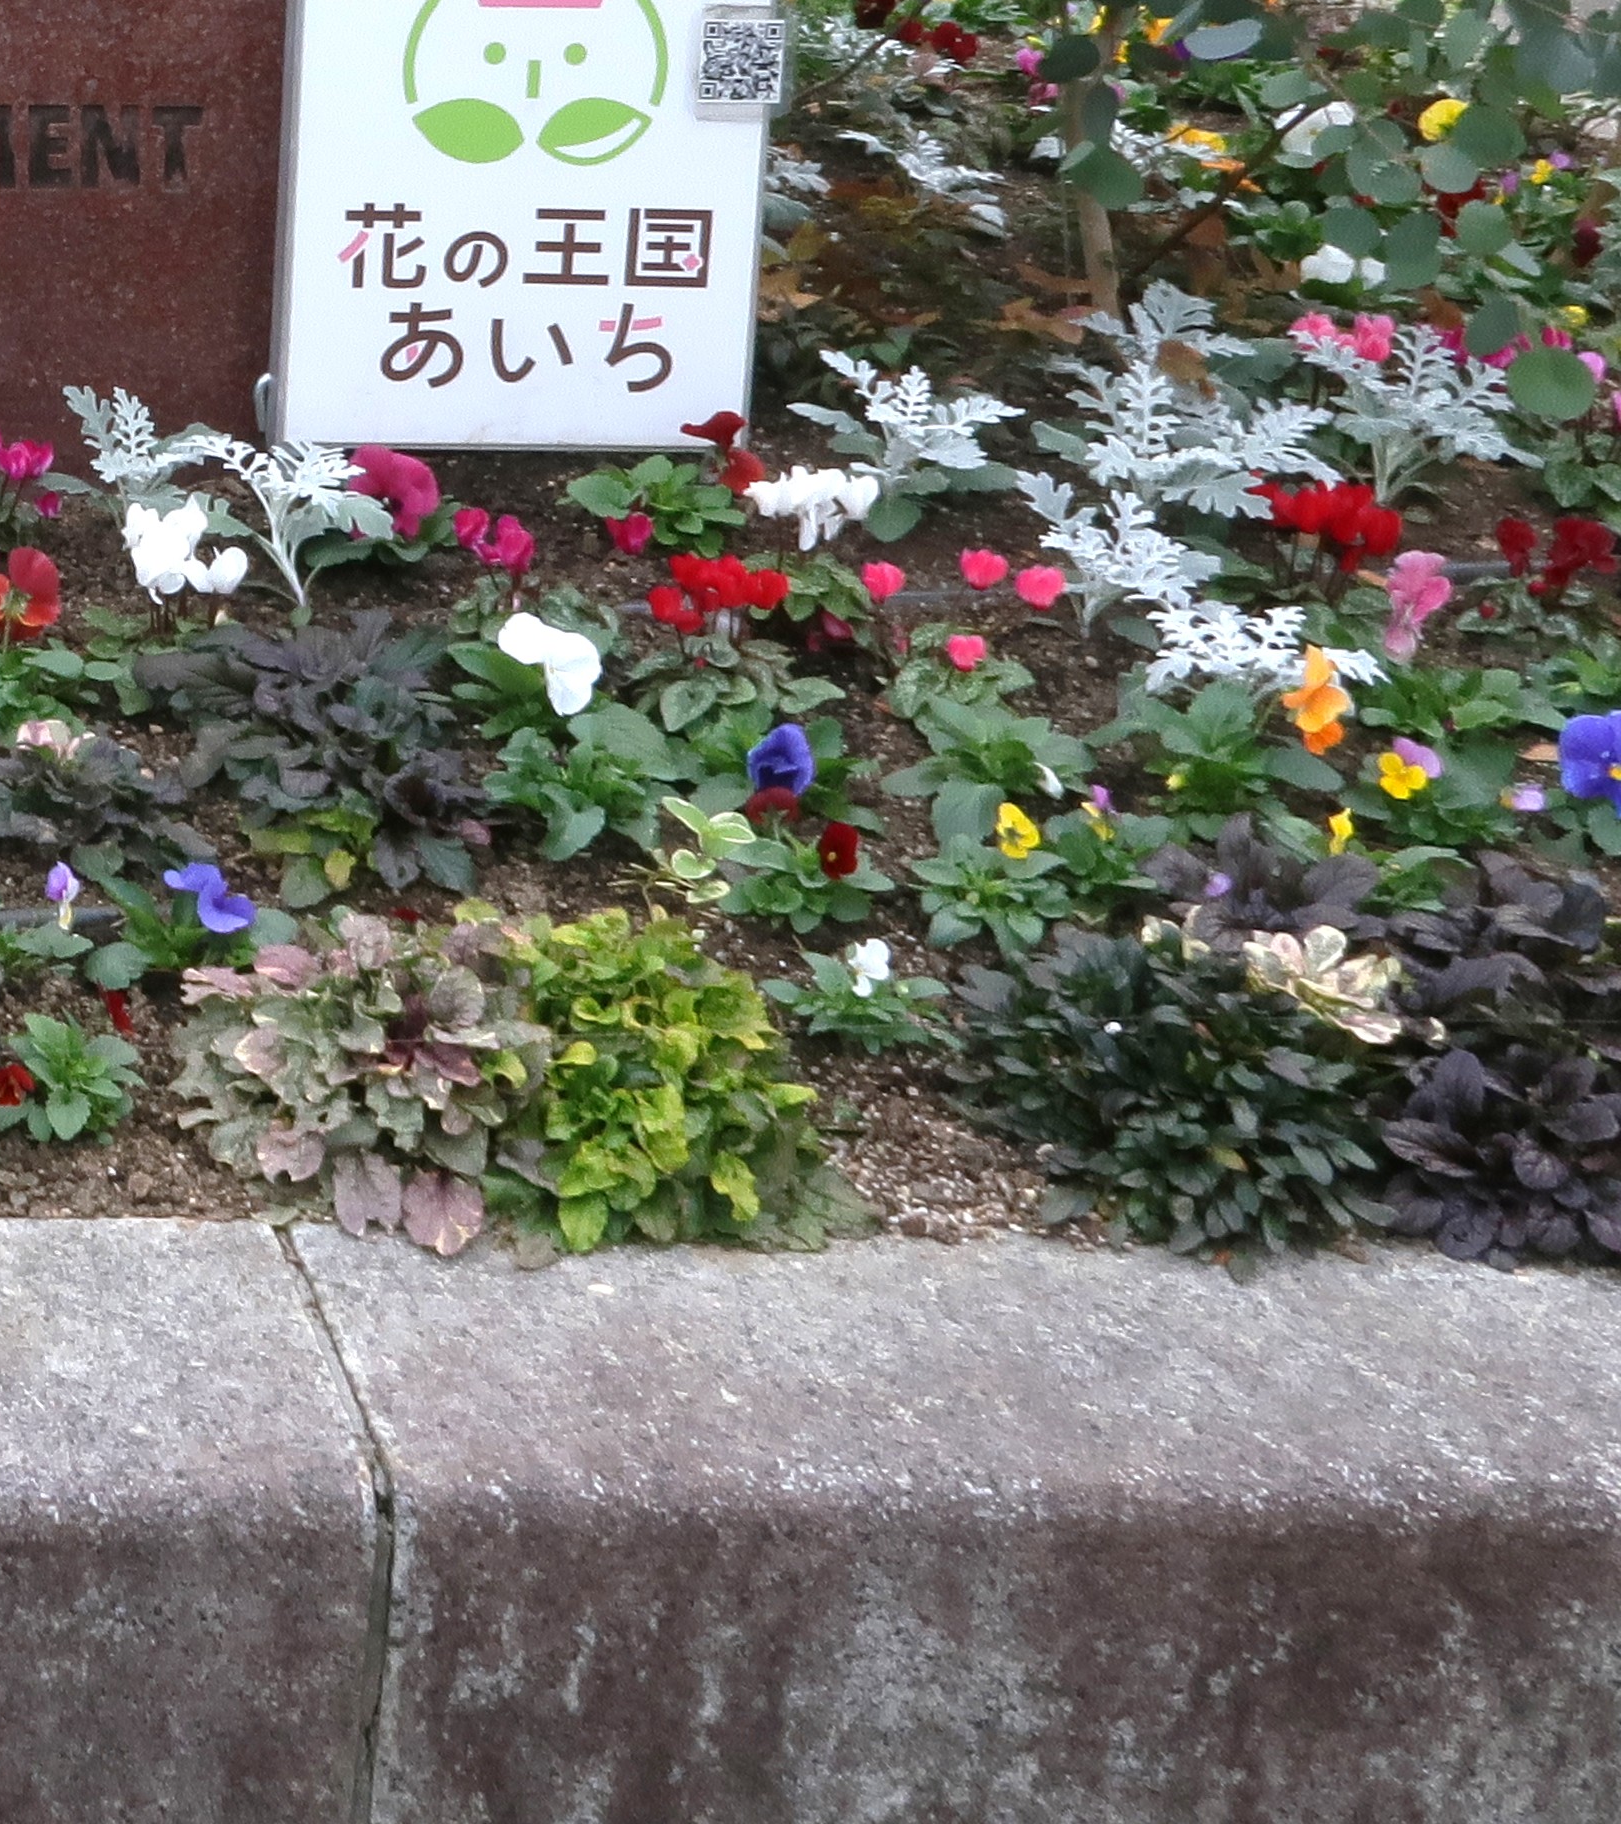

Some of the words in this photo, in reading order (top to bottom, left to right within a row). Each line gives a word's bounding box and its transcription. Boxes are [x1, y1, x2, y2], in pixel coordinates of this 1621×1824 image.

[338, 202, 714, 289] 花の王国
[379, 301, 674, 393] あいち
